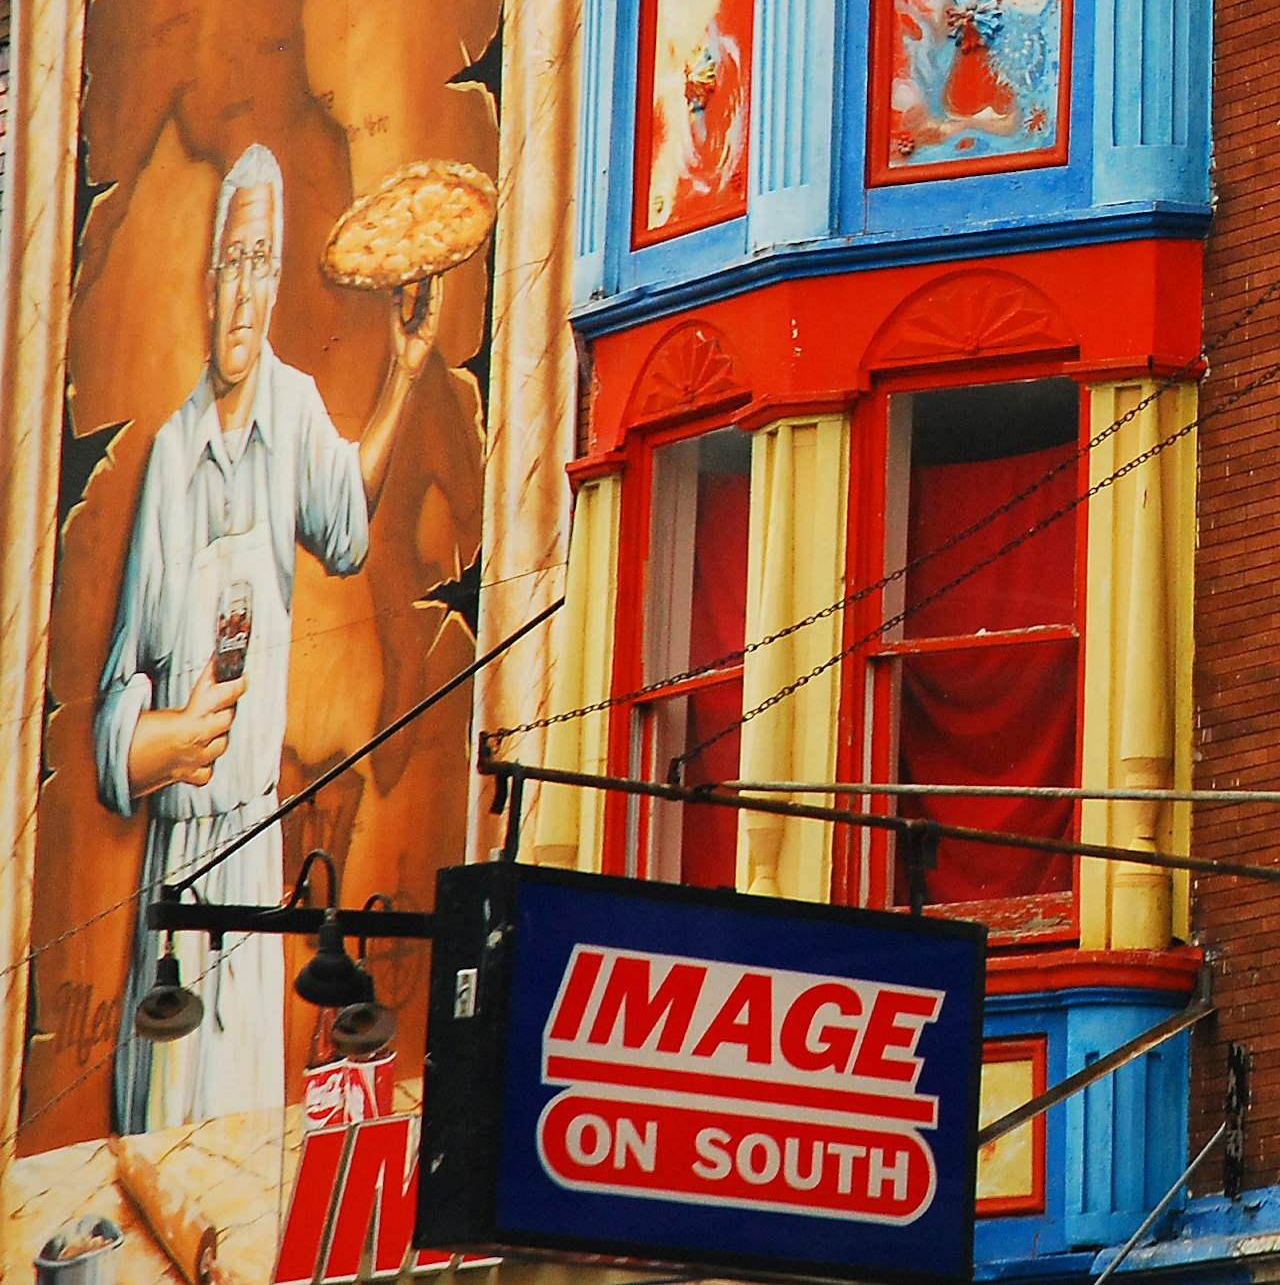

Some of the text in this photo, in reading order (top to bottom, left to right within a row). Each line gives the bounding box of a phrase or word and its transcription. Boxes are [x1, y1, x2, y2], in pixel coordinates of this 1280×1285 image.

[549, 951, 940, 1083] IMAGE
[564, 1113, 910, 1202] ON SOUTH
